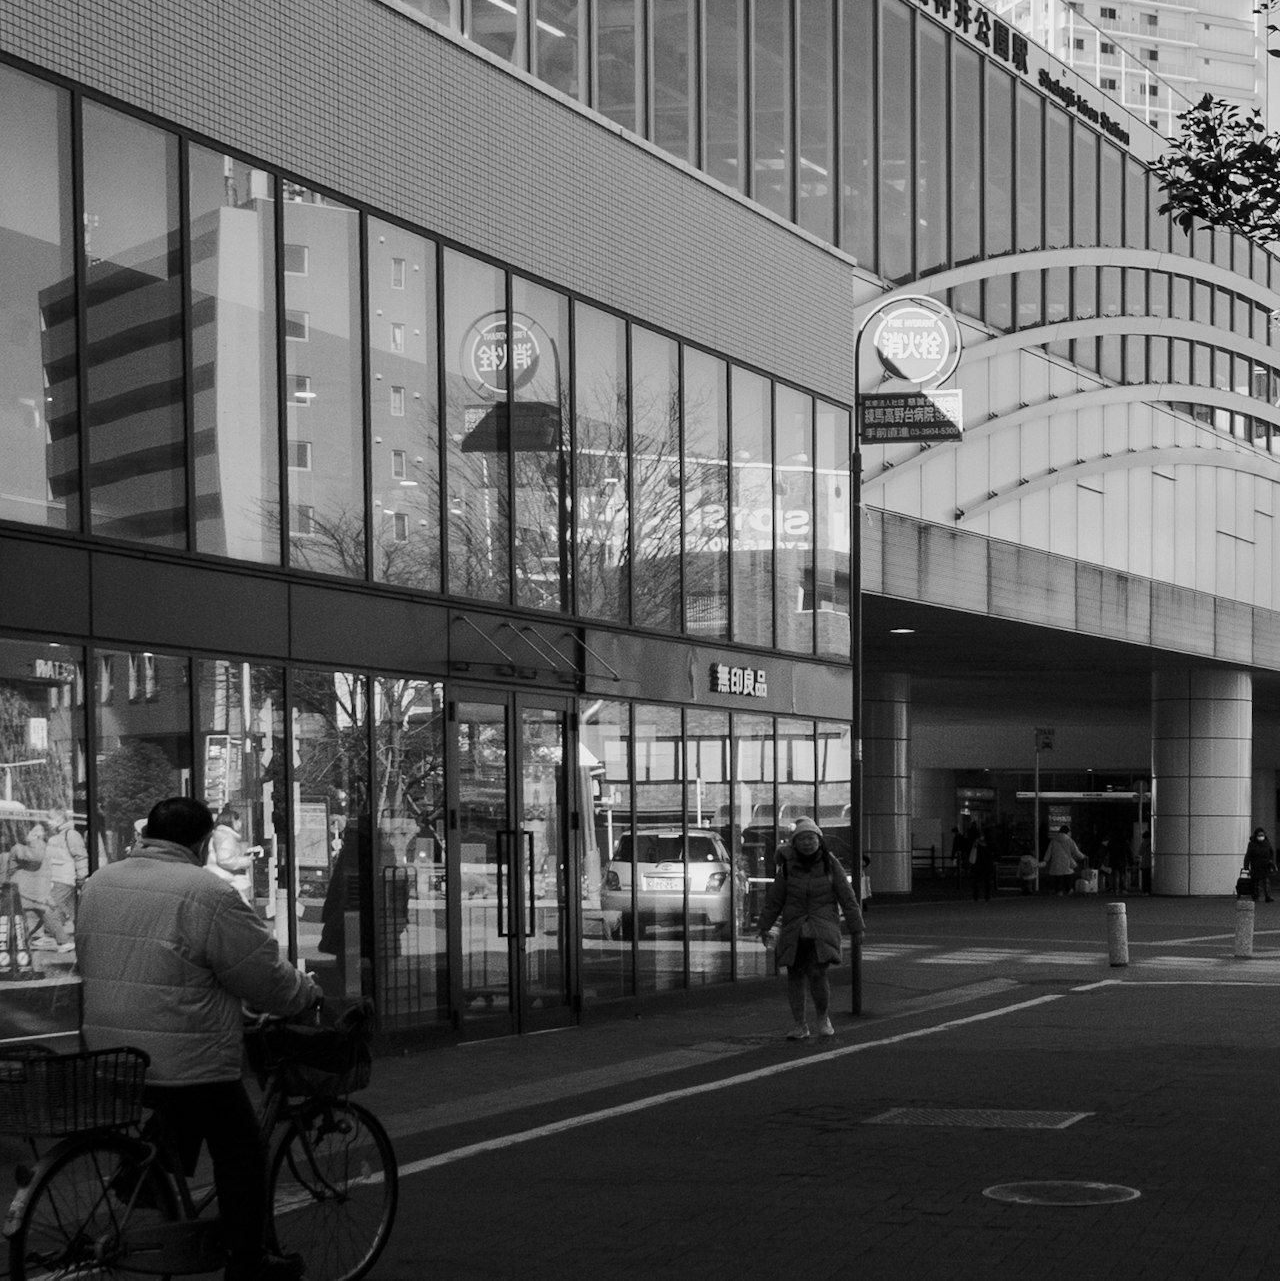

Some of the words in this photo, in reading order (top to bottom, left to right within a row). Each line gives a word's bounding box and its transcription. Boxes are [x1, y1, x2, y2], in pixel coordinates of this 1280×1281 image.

[1100, 111, 1130, 146] Station
[888, 319, 904, 328] FIRE
[904, 318, 935, 328] HYDRANT
[881, 331, 943, 360] 消火栓
[864, 407, 935, 424] 練馬高野台病院
[865, 427, 910, 439] 手前直進
[717, 663, 768, 698] 無印良品
